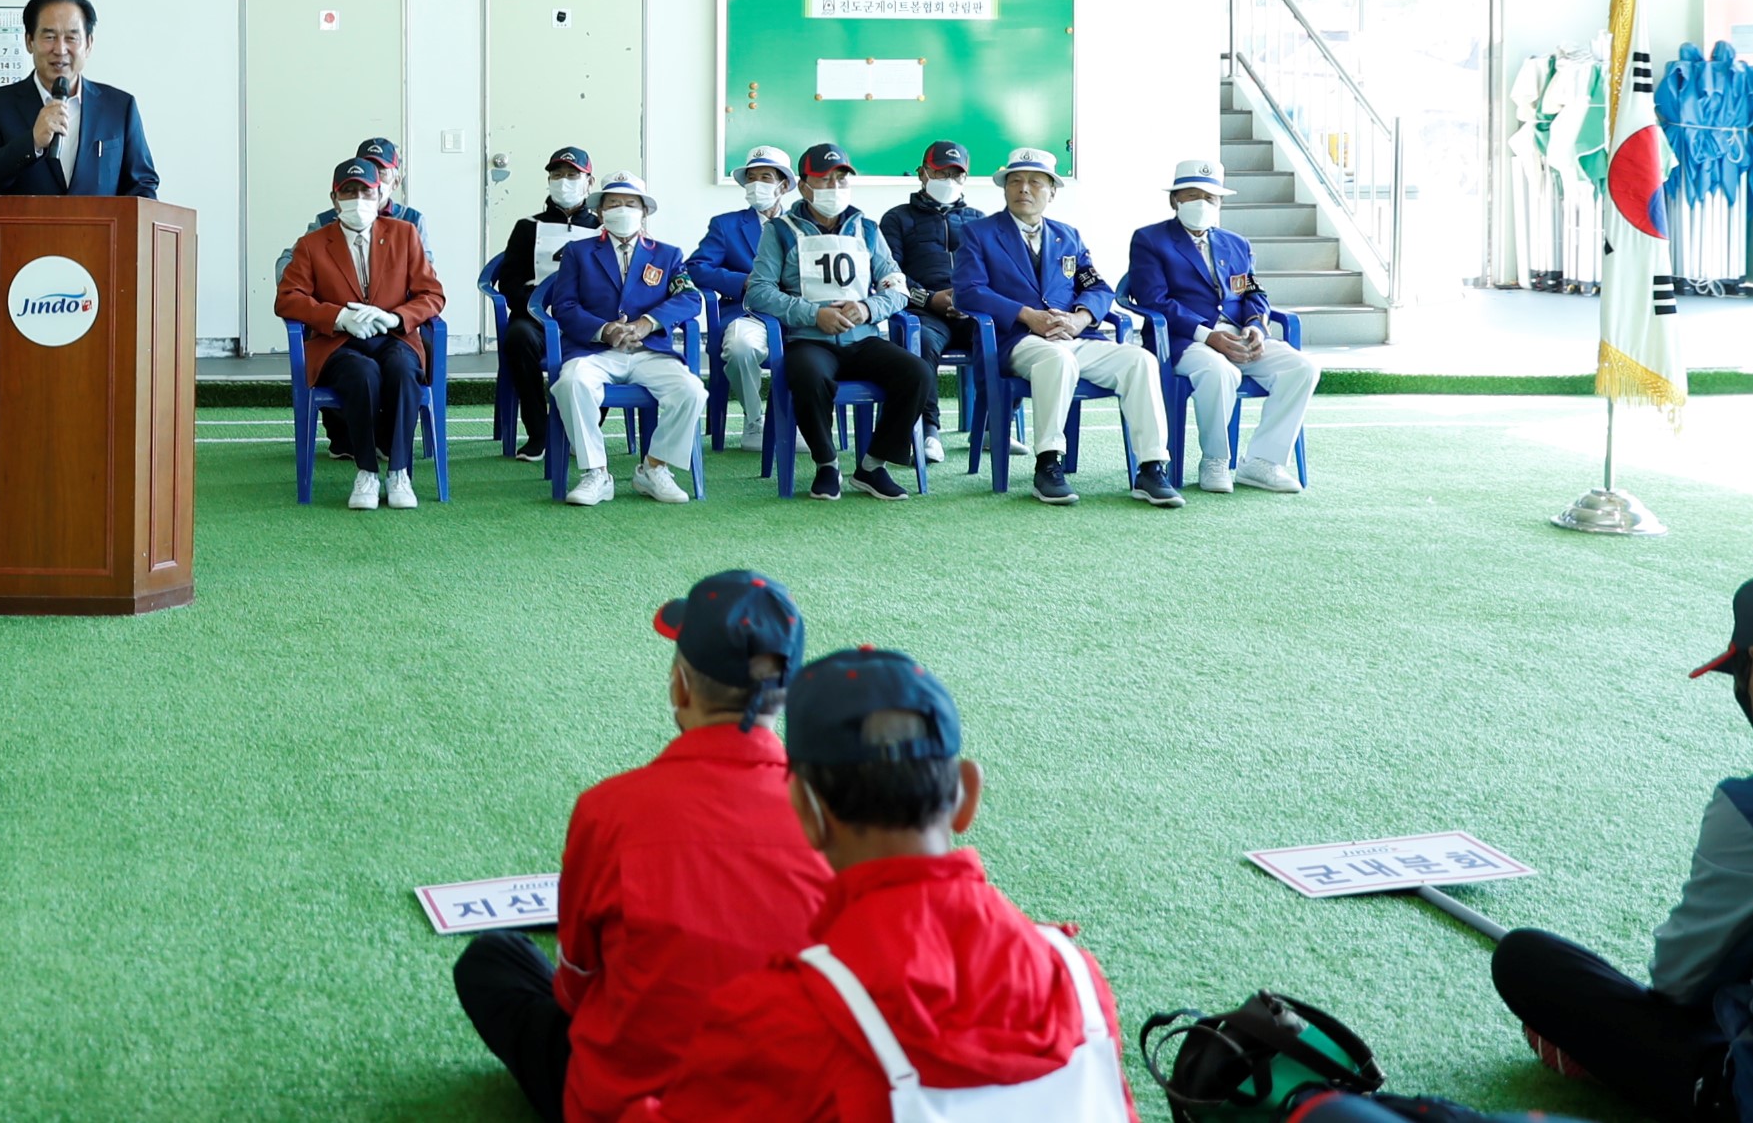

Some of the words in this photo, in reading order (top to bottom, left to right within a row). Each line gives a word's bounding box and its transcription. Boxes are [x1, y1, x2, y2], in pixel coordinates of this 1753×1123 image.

[1, 76, 10, 84] 21
[815, 253, 856, 287] 10
[17, 298, 80, 317] Jindo
[1296, 849, 1501, 886] 군내분회
[453, 892, 550, 918] 지산
